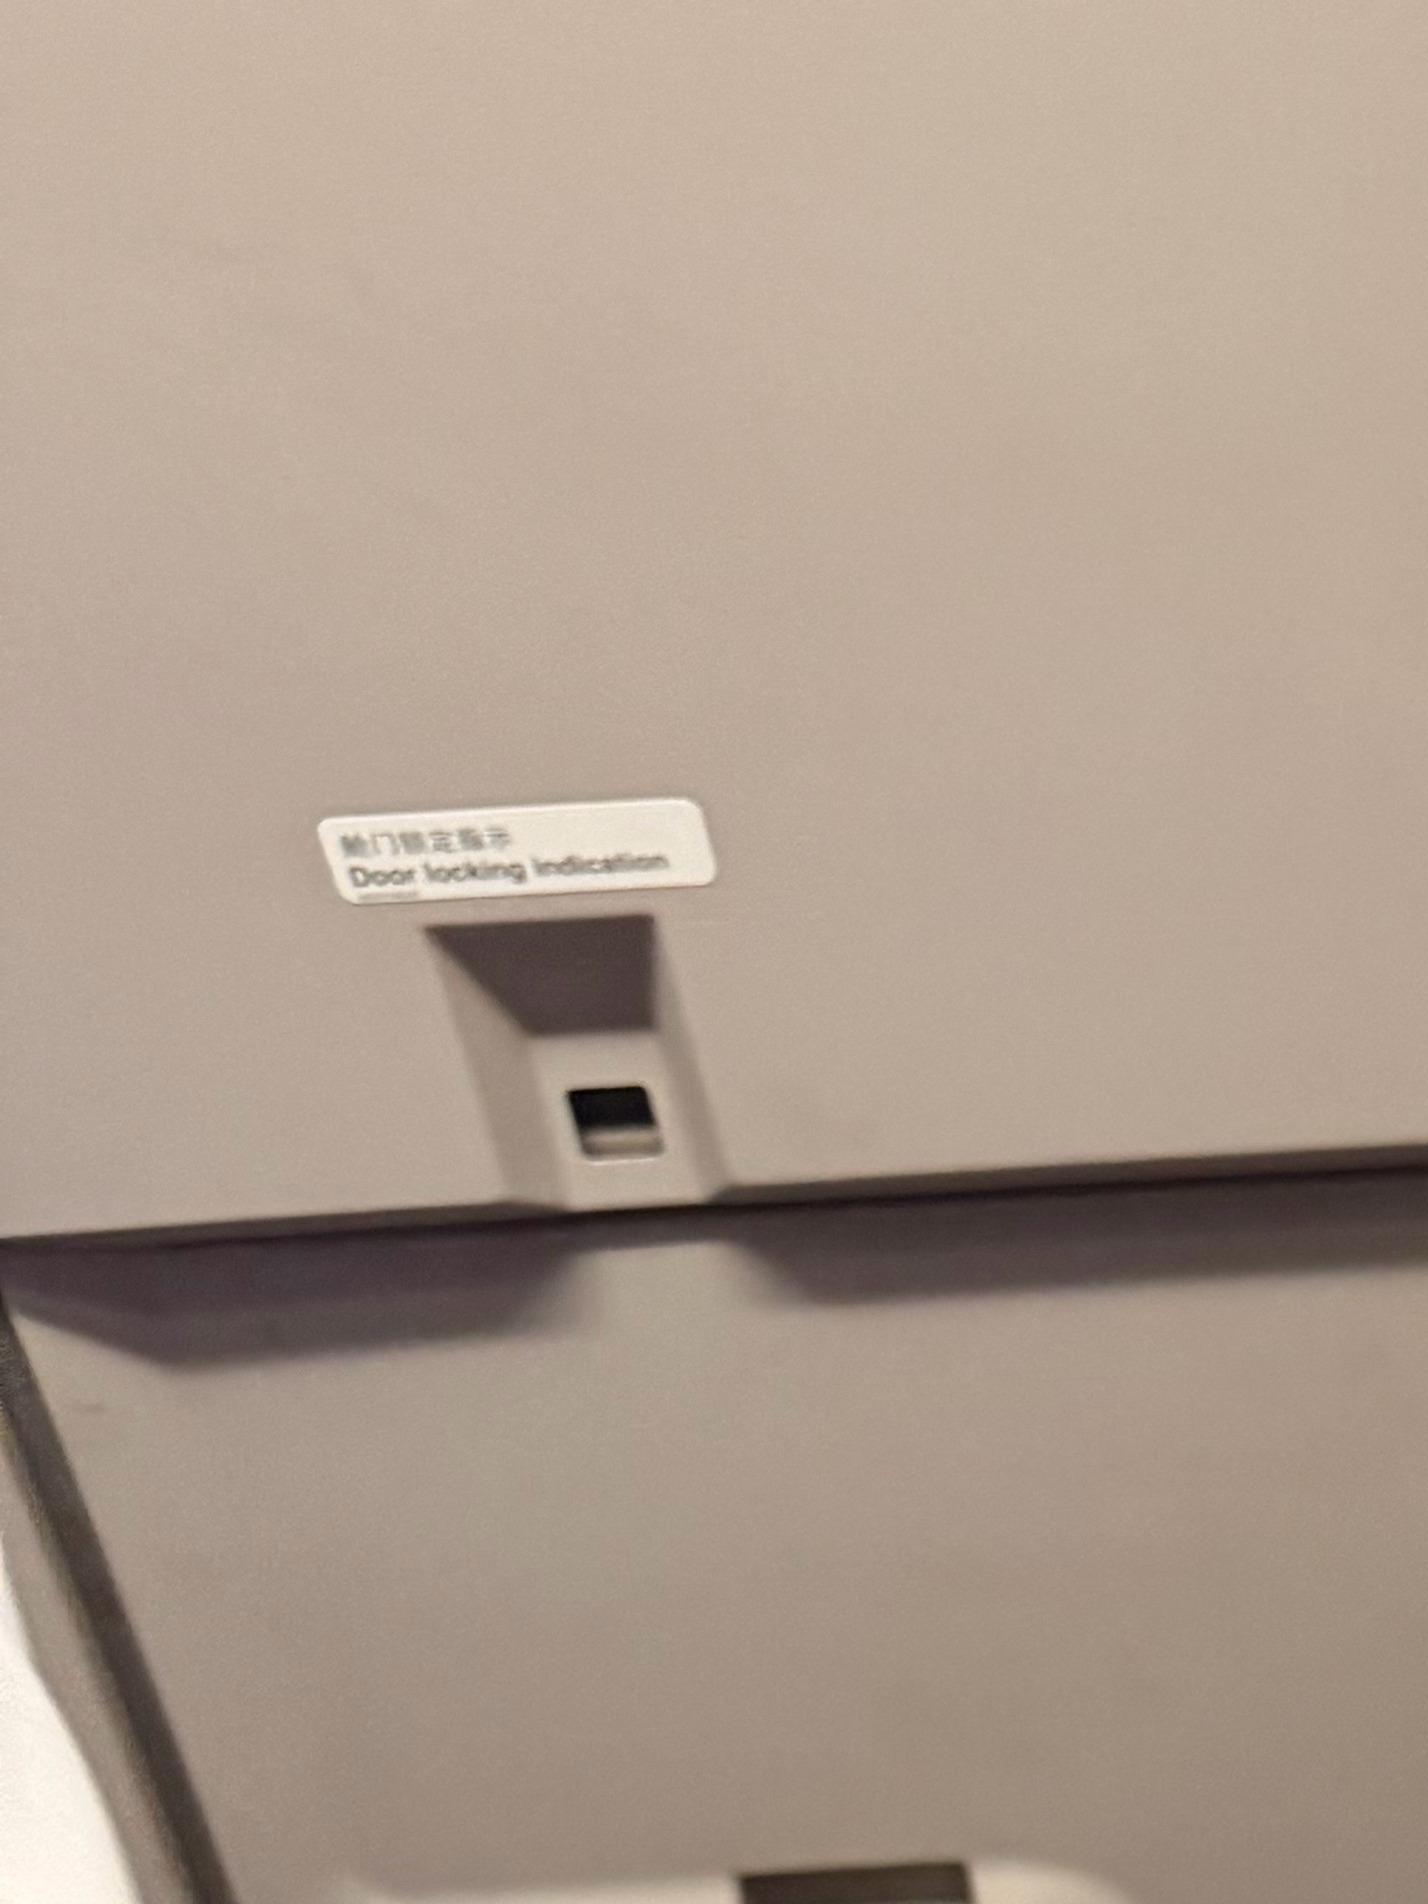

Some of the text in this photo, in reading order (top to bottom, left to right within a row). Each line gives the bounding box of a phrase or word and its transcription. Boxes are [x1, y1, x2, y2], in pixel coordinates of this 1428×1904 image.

[349, 854, 669, 888] Door locking indication
